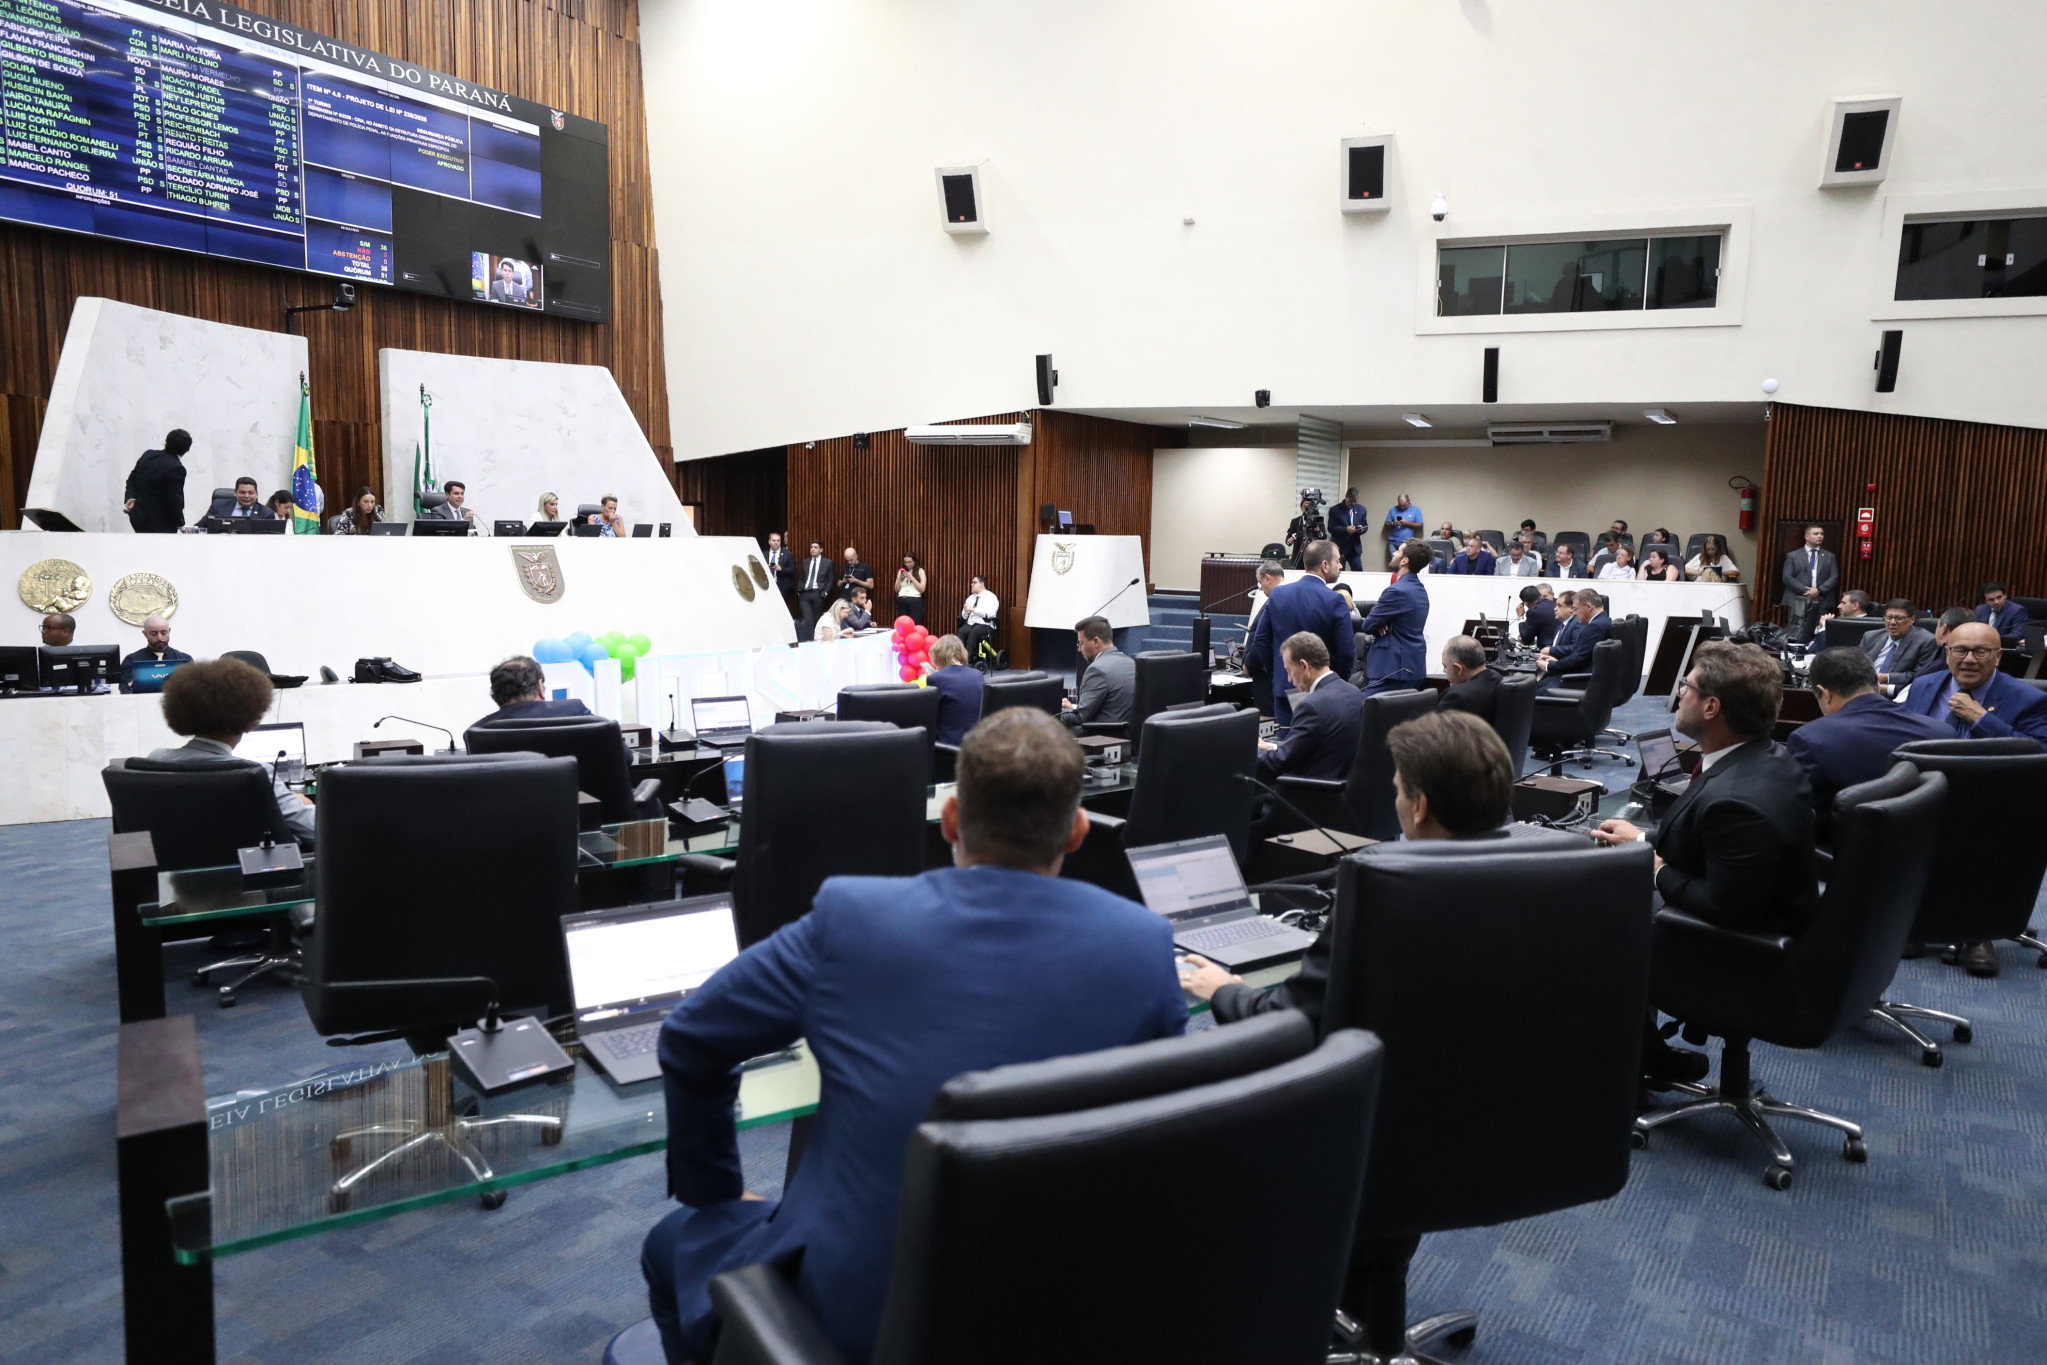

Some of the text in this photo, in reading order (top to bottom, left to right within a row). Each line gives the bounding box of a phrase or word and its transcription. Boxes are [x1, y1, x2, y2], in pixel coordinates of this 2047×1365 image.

[15, 0, 59, 13] NTENOR
[16, 4, 62, 24] LEÔNIDAS
[44, 23, 80, 38] ARAÚJO
[132, 29, 142, 38] PT
[33, 38, 96, 62] FRANCISCHINI
[129, 38, 147, 48] CDN
[160, 37, 222, 61] MARIA VICTORIA
[1, 40, 84, 70] GILBERTO RIBEIRO
[130, 47, 147, 57] PSD
[148, 0, 212, 20] EIA
[219, 8, 382, 73] LEGISLATIVA
[389, 63, 421, 84] DO
[428, 74, 512, 112] PARANÁ
[160, 46, 184, 59] MARLI
[186, 54, 218, 68] PAULINO
[1, 50, 84, 78] GILSON DE SOUZA
[2, 60, 36, 74] GOURA
[127, 55, 151, 68] NOVO
[134, 66, 146, 75] SD
[162, 65, 224, 87] MAURO MORAES
[3, 69, 64, 91] GUGU BUENO
[136, 76, 146, 85] PL
[162, 75, 196, 89] MOACYR
[4, 80, 72, 102] HUSSEIN BAKRI
[136, 85, 146, 94] PL
[163, 84, 225, 105] NELSON JUSTUS
[4, 90, 70, 112] JAIRO TAMURA
[133, 94, 149, 103] PDT
[163, 93, 226, 114] NEY LEPREVOST
[307, 83, 322, 93] ITEM
[346, 95, 374, 107] PROJETO
[385, 105, 395, 114] LEI
[6, 100, 90, 126] LUCIANA RAFAGNIN
[134, 103, 150, 112] PSD
[164, 101, 219, 121] PAULO GOMES
[272, 104, 286, 113] PSD
[6, 110, 56, 127] LUIS CORTI
[134, 112, 150, 121] PSD
[164, 110, 239, 135] PROFESSOR LEMOS
[138, 121, 148, 130] PL
[165, 119, 220, 138] REICHEMBACH
[6, 119, 118, 150] LUIZ CLAUDIO ROMANELLI
[138, 131, 149, 139] PT
[8, 128, 117, 159] LUIZ FERNANDO GUERRA
[8, 138, 71, 159] MABEL CANTO
[136, 140, 152, 149] PSB
[198, 136, 229, 150] FREITAS
[274, 146, 288, 154] PSD
[136, 149, 152, 158] PSD
[166, 147, 234, 168] RICARDO ARRUDA
[203, 145, 224, 157] FILHO
[418, 148, 464, 164] PODER EXECUTIVO
[9, 148, 90, 172] MARCELO RANGEL
[275, 163, 289, 171] PDT
[437, 160, 464, 172] APROVADO
[10, 158, 89, 181] MARCIO PACHECO
[140, 167, 151, 175] PP
[278, 172, 286, 180] PL
[138, 176, 154, 185] PSD
[168, 174, 258, 199] SOLDADO ADRIANO JOSÉ
[216, 175, 244, 187] MARCIA
[66, 183, 118, 199] QUORUM: 51
[169, 192, 197, 203] THIAGO
[205, 190, 229, 200] TURINI
[276, 188, 290, 196] PSD
[357, 247, 371, 255] NÃO
[360, 240, 370, 248] SIM
[333, 250, 371, 262] ABSTENÇÃO
[352, 260, 371, 269] TOTAL
